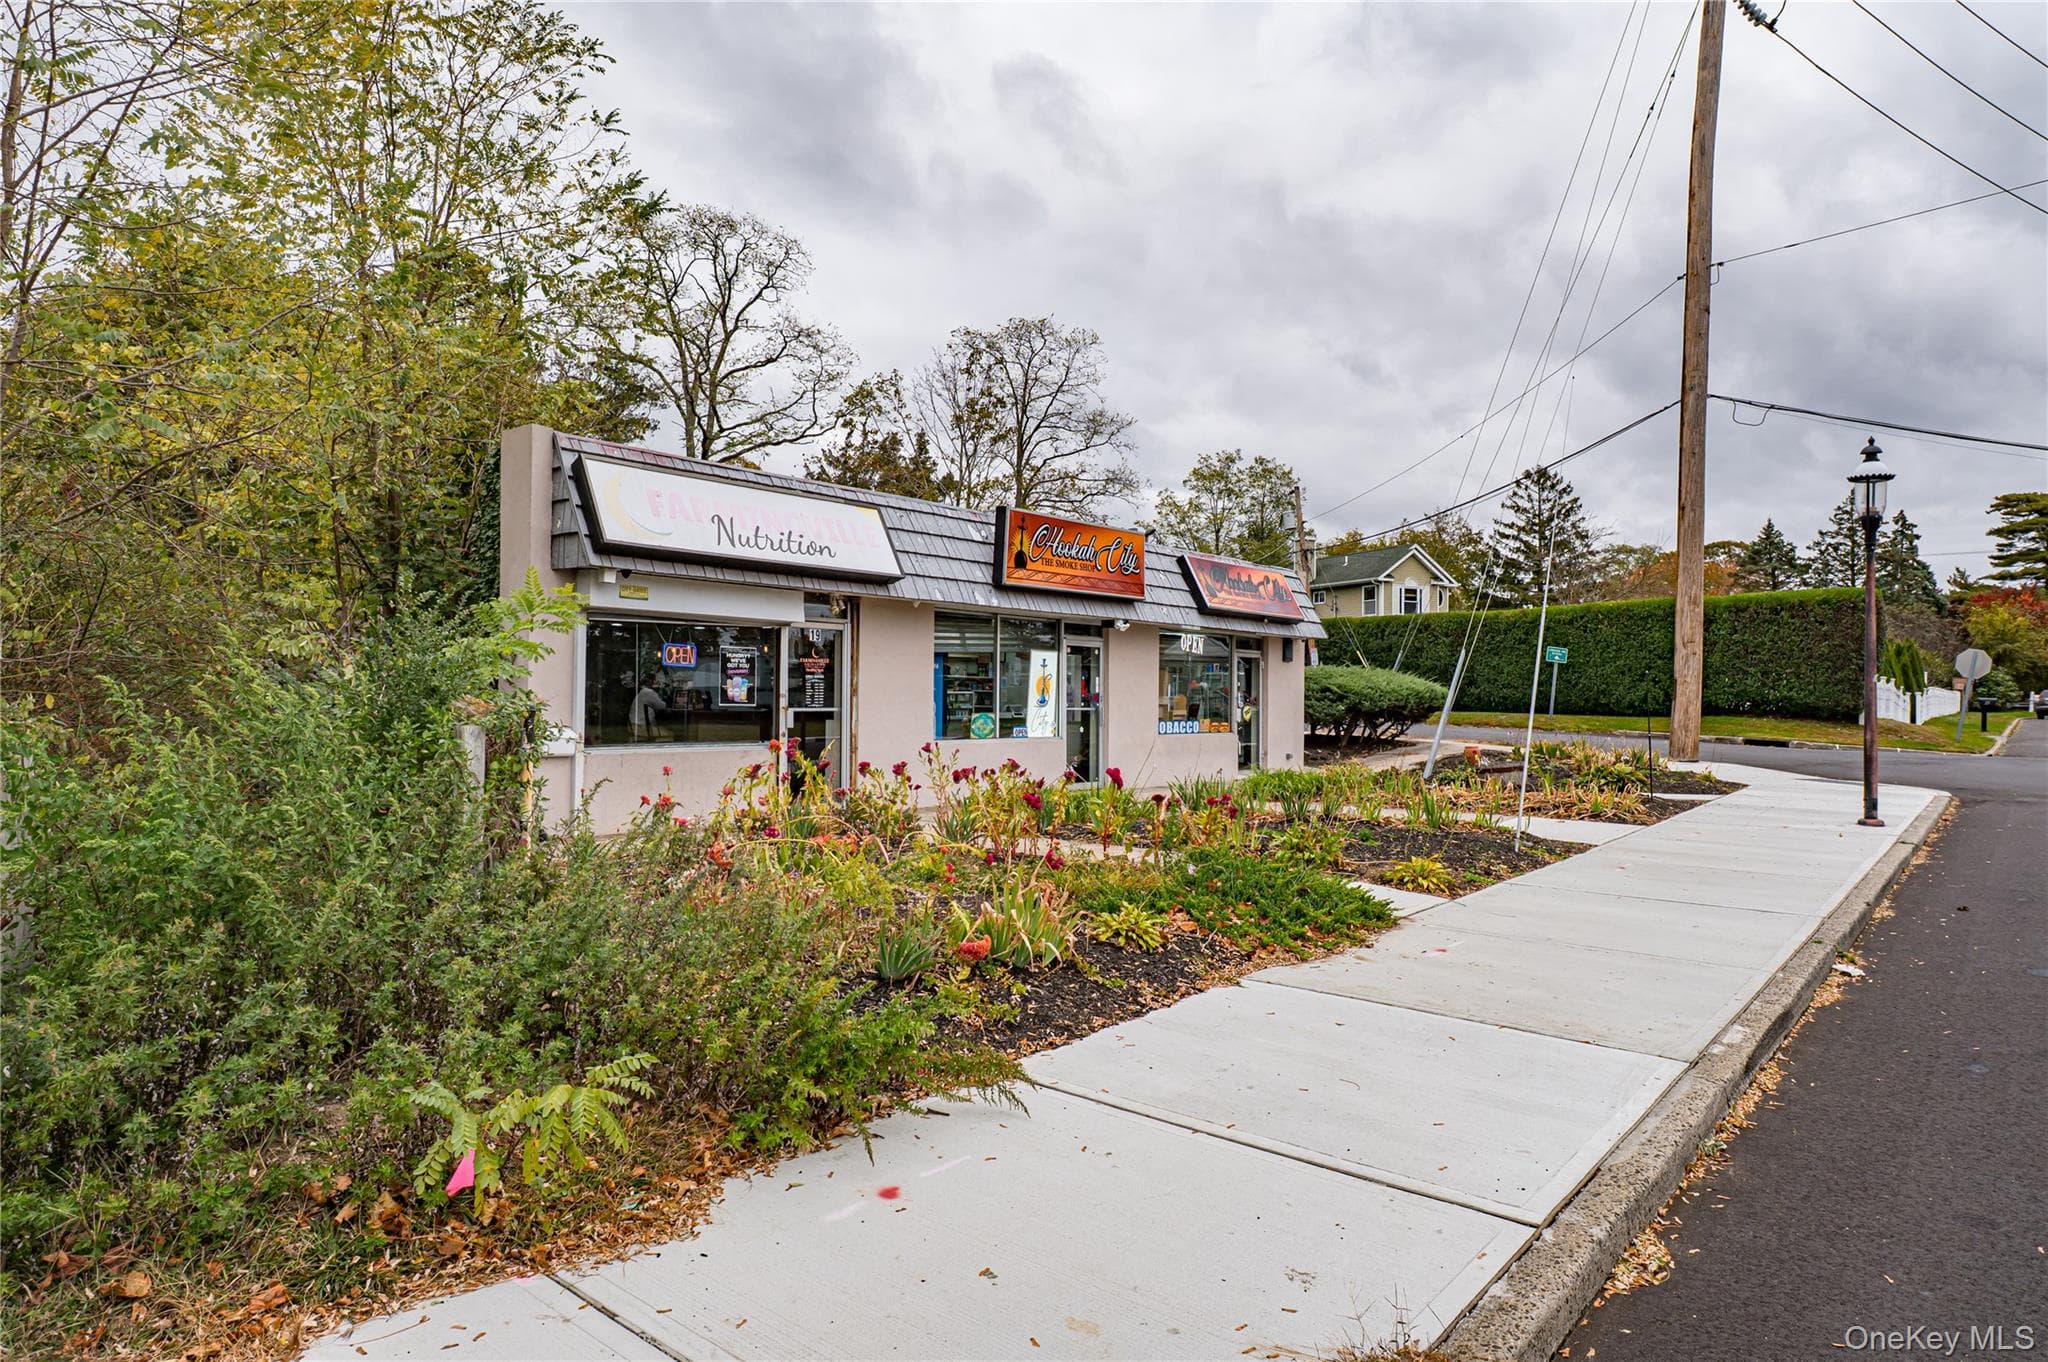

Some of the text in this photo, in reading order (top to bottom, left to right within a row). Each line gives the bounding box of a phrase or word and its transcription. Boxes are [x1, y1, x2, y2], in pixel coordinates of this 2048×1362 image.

[711, 513, 837, 559] Nutrition
[1030, 524, 1140, 575] Hookah City
[1041, 557, 1097, 573] THE SMOKE SHOP
[810, 629, 821, 641] 19
[1180, 634, 1205, 656] OPEN
[665, 646, 695, 665] OPEN
[1159, 720, 1200, 734] OBACCO
